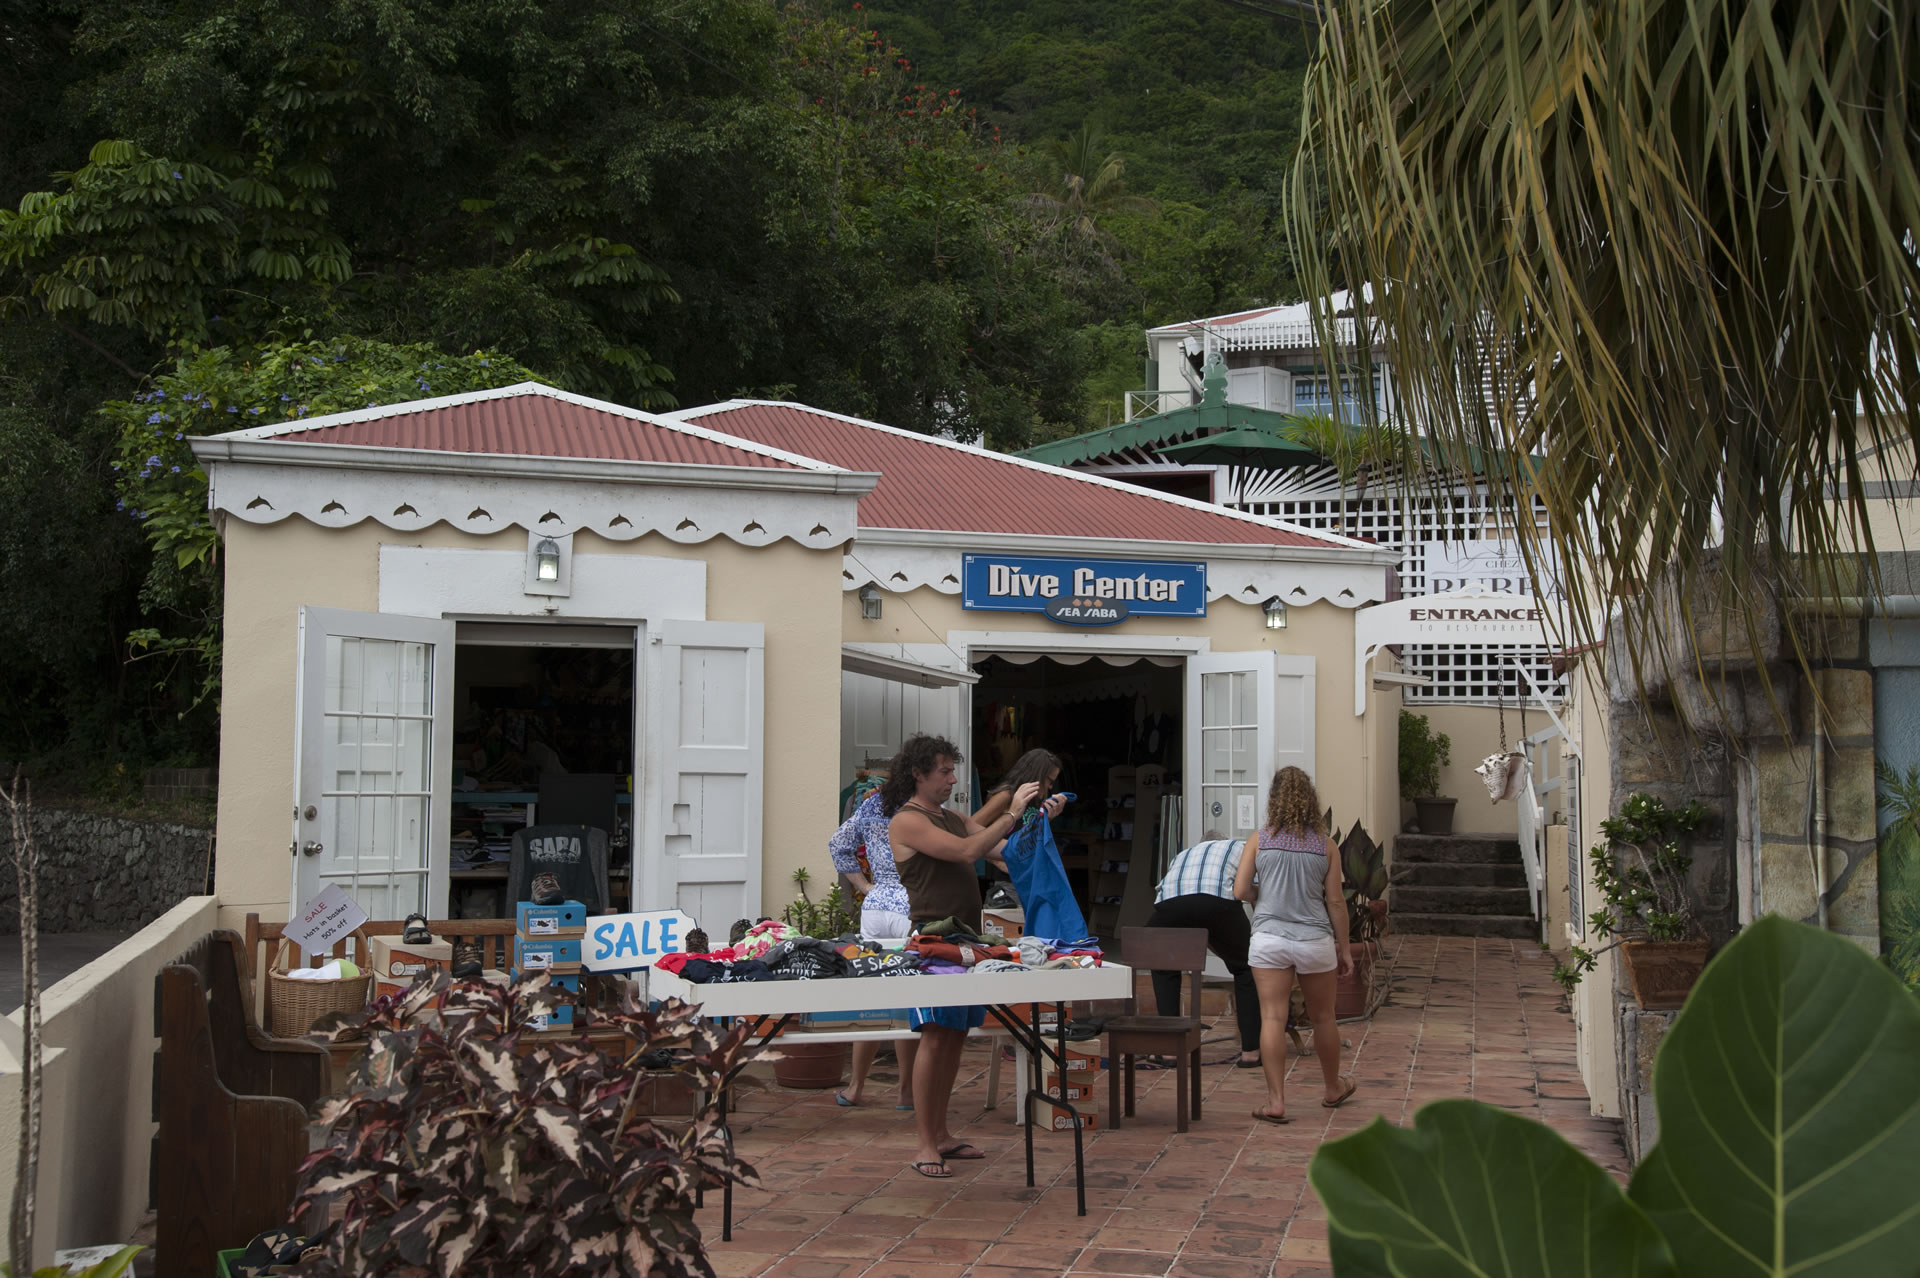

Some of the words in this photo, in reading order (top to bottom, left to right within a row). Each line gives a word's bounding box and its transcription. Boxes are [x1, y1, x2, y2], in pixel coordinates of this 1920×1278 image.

[1485, 560, 1520, 569] CHEZ
[988, 564, 1059, 598] Dive
[1073, 567, 1185, 602] Center
[1056, 607, 1081, 617] SEA
[1083, 607, 1118, 619] SABA
[1409, 608, 1545, 622] ENTRANCE
[303, 926, 320, 940] Hats
[326, 903, 348, 921] basket
[304, 902, 328, 923] SALE
[321, 927, 336, 940] 50%
[337, 918, 348, 929] off
[593, 917, 679, 960] SALE
